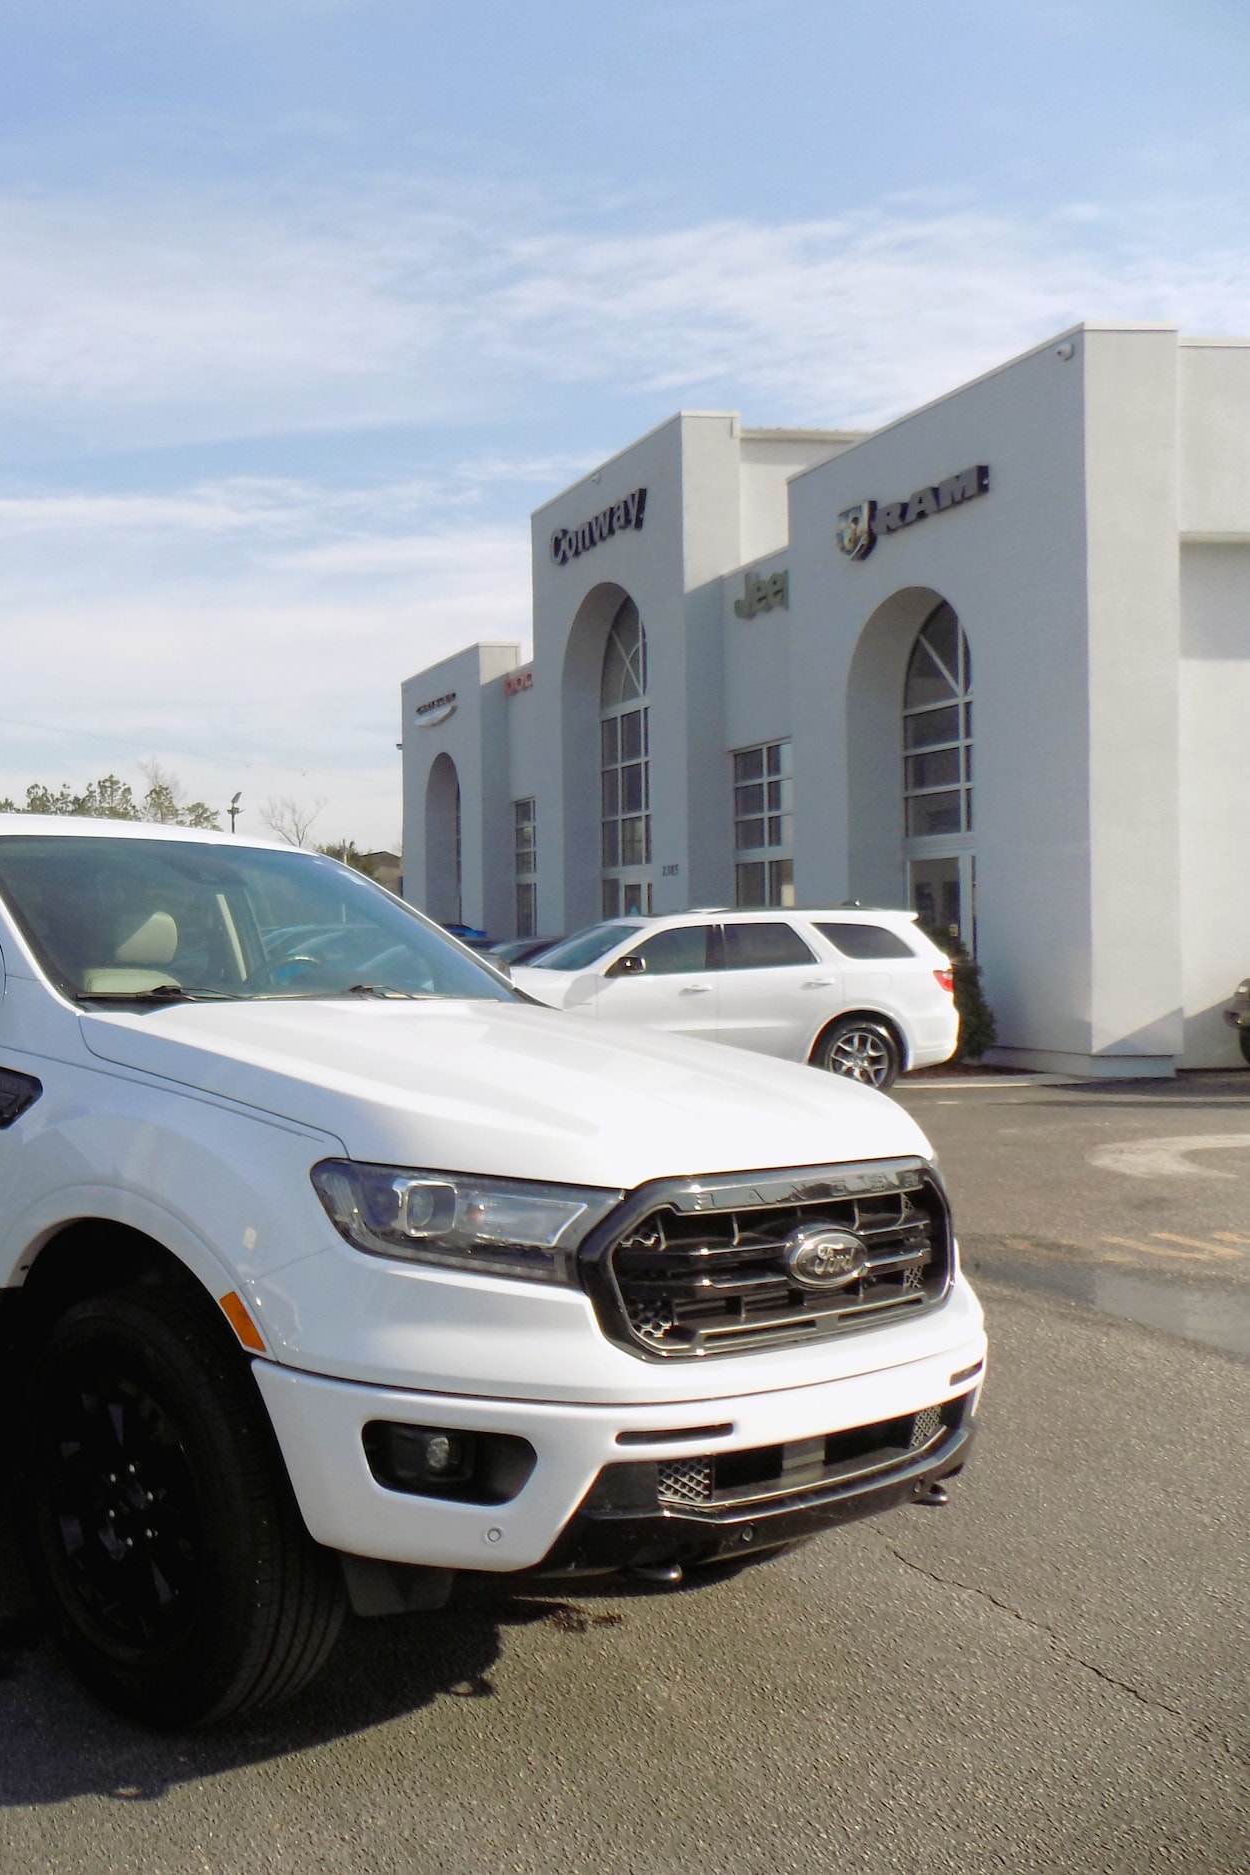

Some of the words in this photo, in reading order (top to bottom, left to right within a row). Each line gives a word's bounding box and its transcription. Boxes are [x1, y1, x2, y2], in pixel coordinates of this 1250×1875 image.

[549, 488, 647, 566] Conway
[872, 465, 989, 536] RAM
[814, 1242, 855, 1276] Ford
